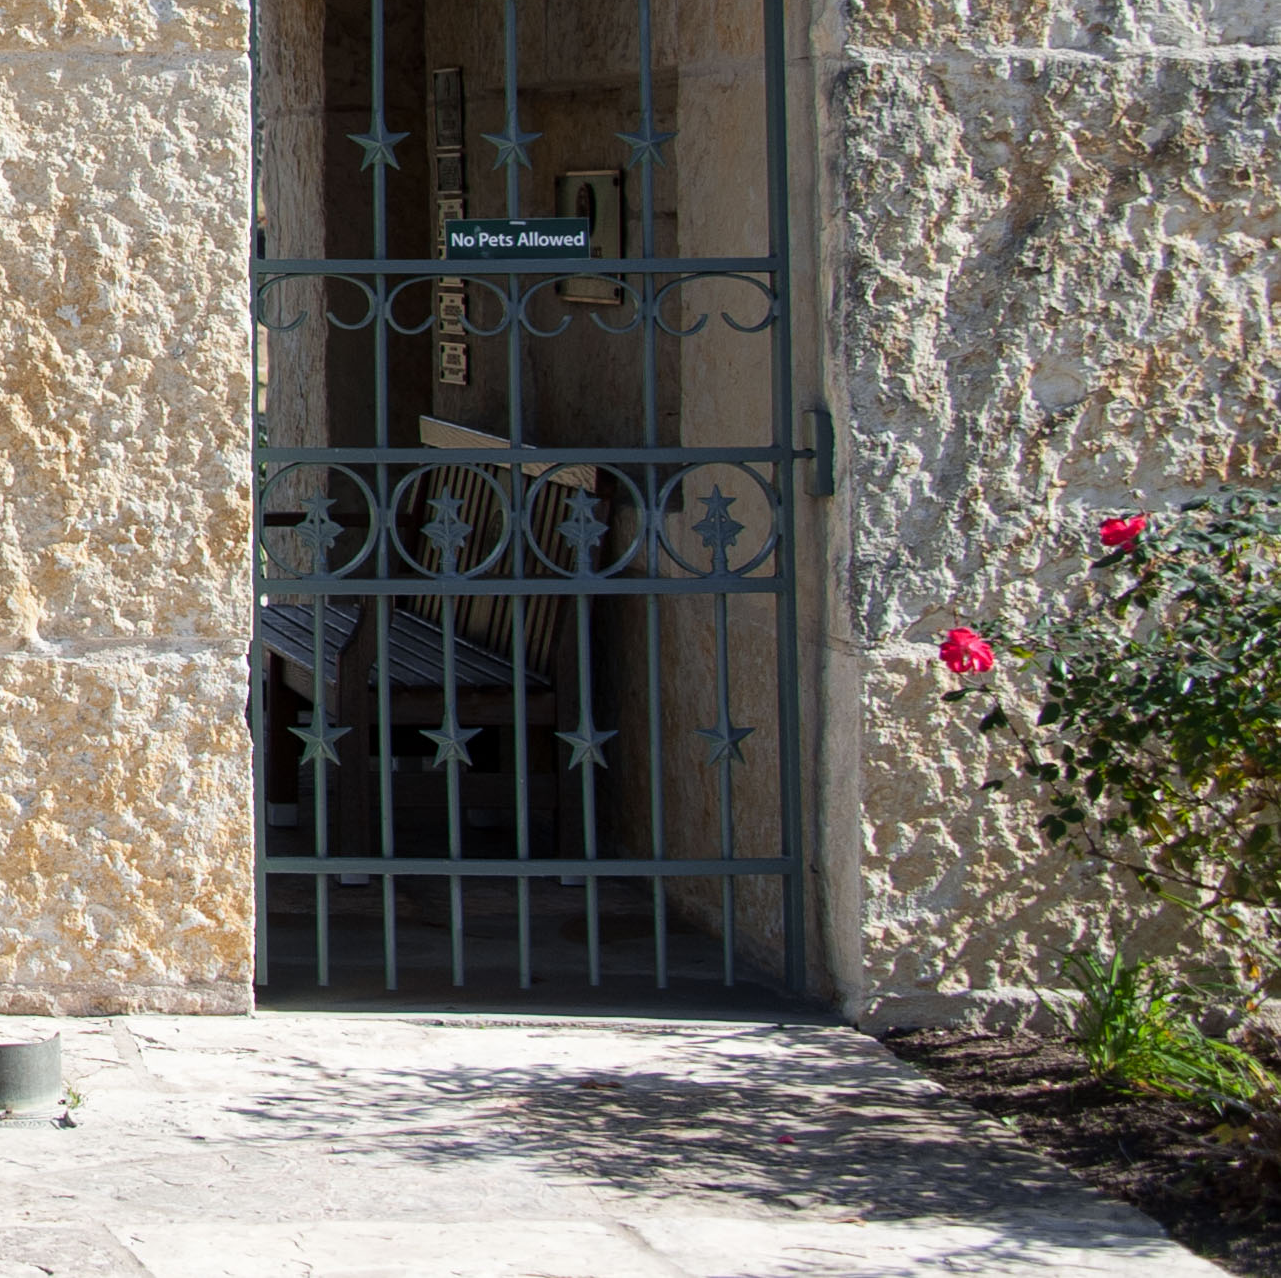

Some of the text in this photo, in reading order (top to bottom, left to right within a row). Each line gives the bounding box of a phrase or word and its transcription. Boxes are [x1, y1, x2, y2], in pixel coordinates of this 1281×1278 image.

[451, 230, 585, 247] No Pets Allowed
